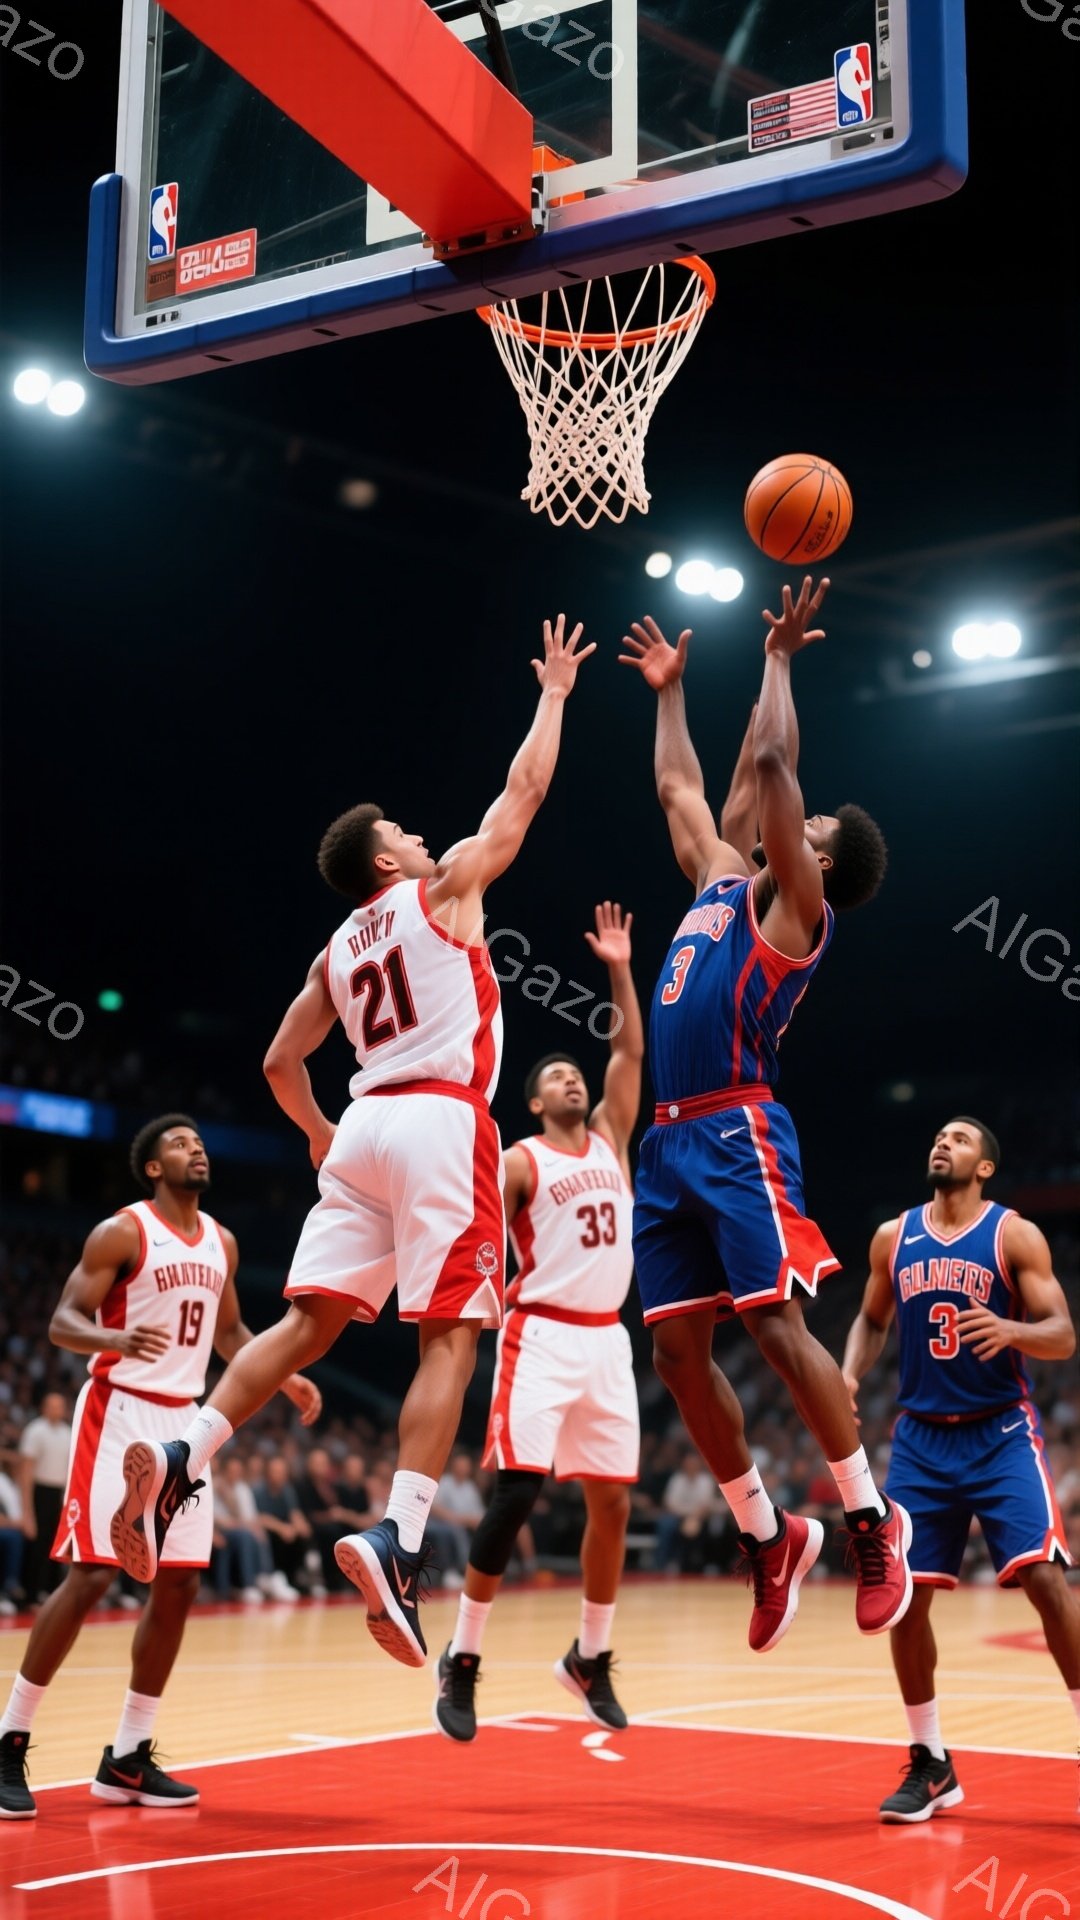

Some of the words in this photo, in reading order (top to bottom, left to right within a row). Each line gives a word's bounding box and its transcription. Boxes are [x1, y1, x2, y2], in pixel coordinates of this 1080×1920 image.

[350, 944, 418, 1052] 21
[661, 945, 696, 1006] 3
[576, 1202, 617, 1249] 33
[178, 1299, 204, 1347] 19
[928, 1302, 960, 1360] 3
